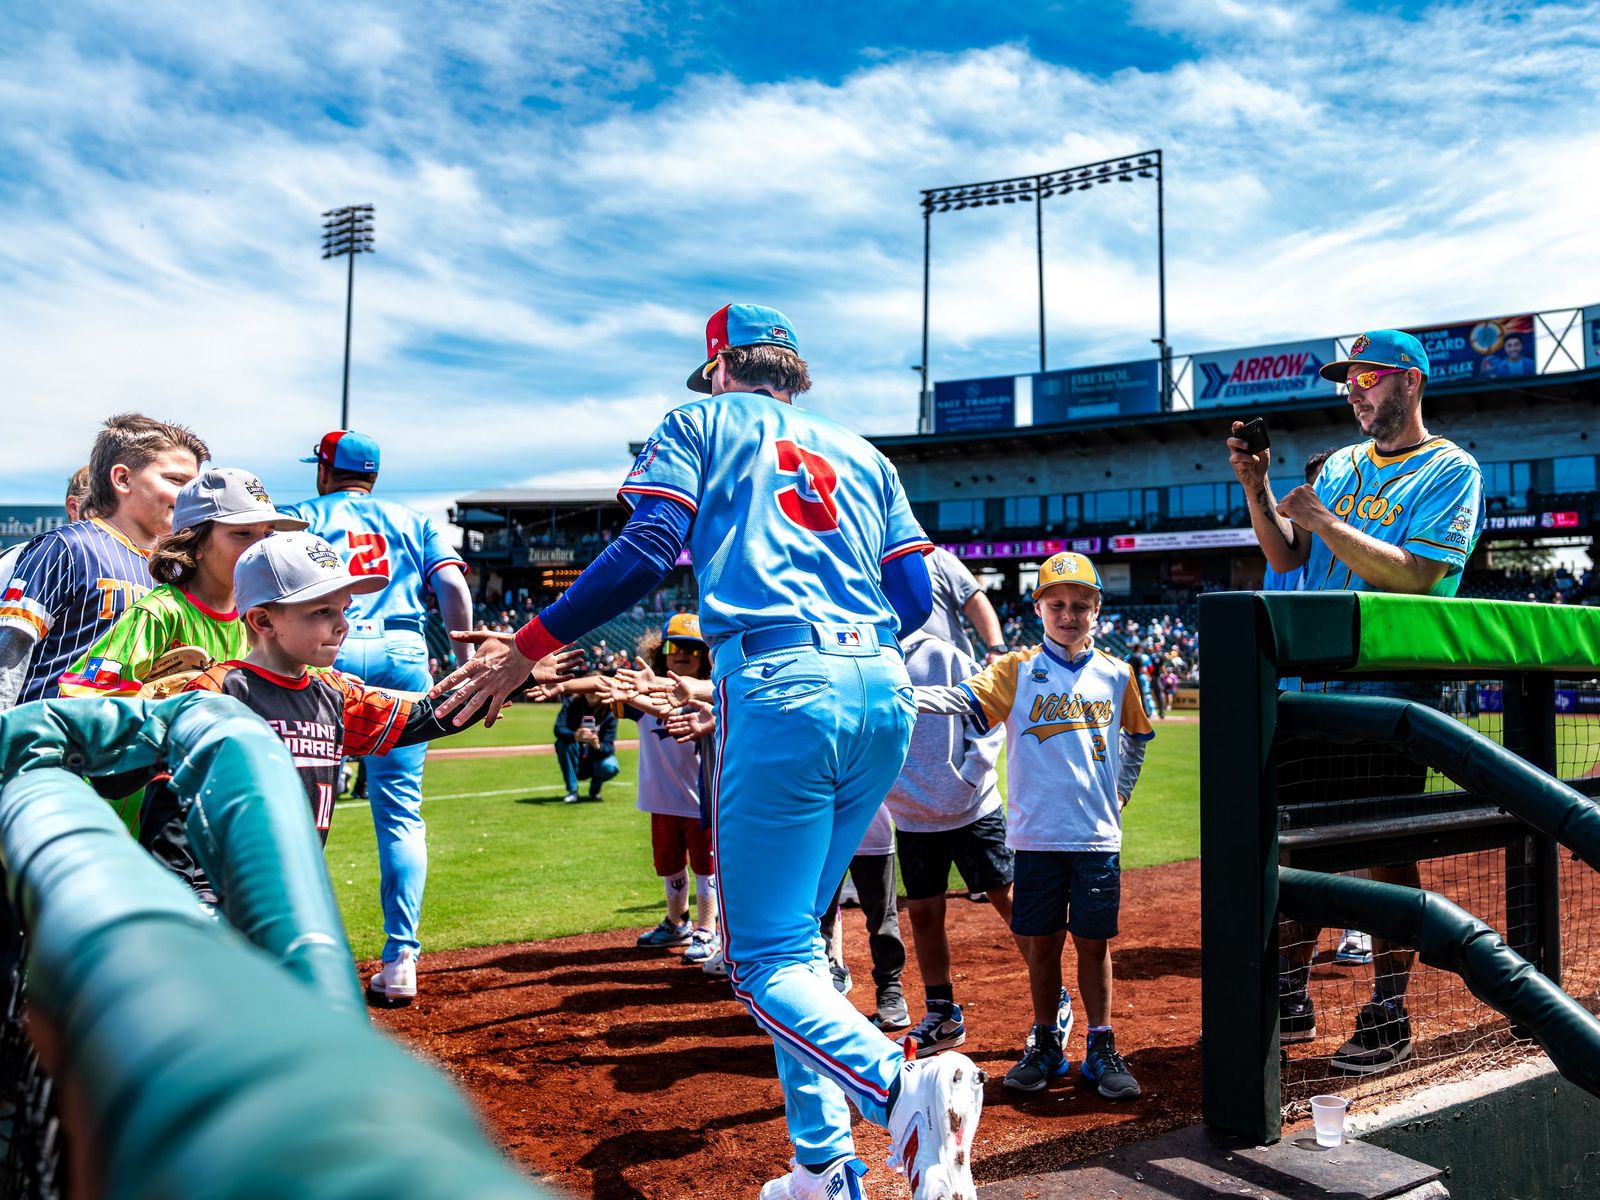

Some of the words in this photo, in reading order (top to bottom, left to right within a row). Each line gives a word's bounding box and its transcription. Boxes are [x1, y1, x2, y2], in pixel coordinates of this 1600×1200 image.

[1425, 337, 1466, 351] CARD
[1071, 369, 1131, 386] FIRETROL
[1229, 352, 1310, 384] ARROW
[1225, 377, 1307, 398] EXTERMINATORS
[773, 438, 841, 535] 3
[1334, 494, 1404, 527] OCOS
[1507, 515, 1536, 528] WIN!
[0, 516, 43, 536] nited
[1445, 531, 1467, 546] 2026
[346, 530, 390, 578] 2
[1029, 693, 1112, 724] Vikings
[1092, 734, 1107, 762] 2
